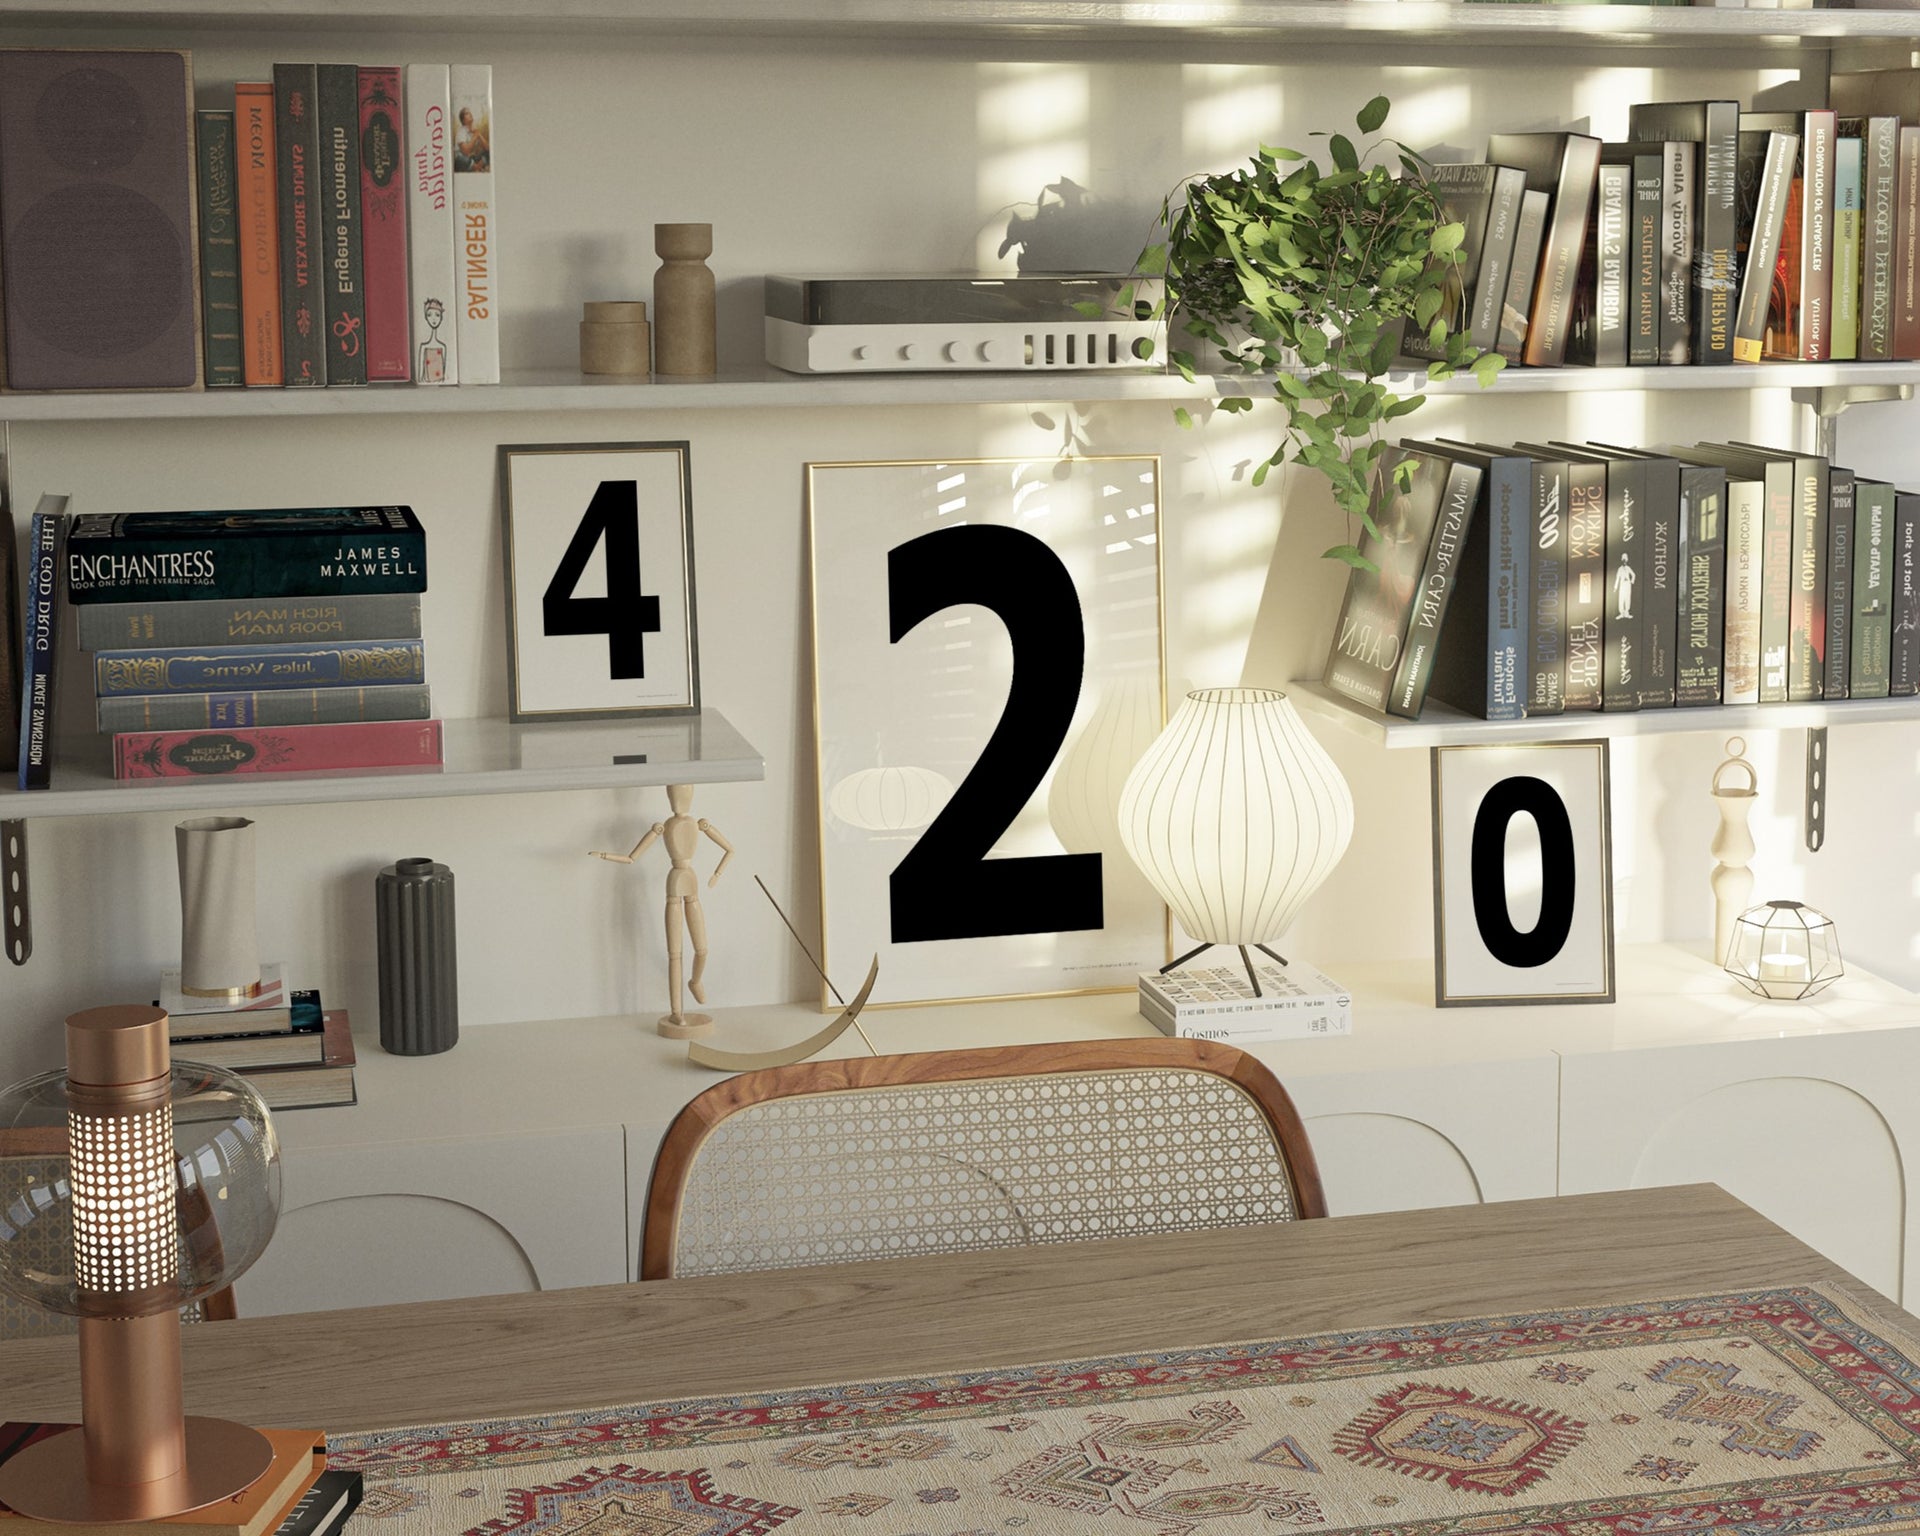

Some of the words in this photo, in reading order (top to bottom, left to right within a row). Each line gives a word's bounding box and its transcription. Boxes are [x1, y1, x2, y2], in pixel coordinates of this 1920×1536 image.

[335, 546, 401, 561] JAMES
[70, 550, 214, 582] ENCHANTRESS
[320, 562, 418, 578] MAXWELL
[153, 577, 191, 586] EVERMEN
[194, 577, 215, 586] SAGA
[542, 480, 661, 680] 4
[888, 524, 1105, 944] 2
[1471, 776, 1575, 968] 0
[1183, 1028, 1230, 1039] Cosmos
